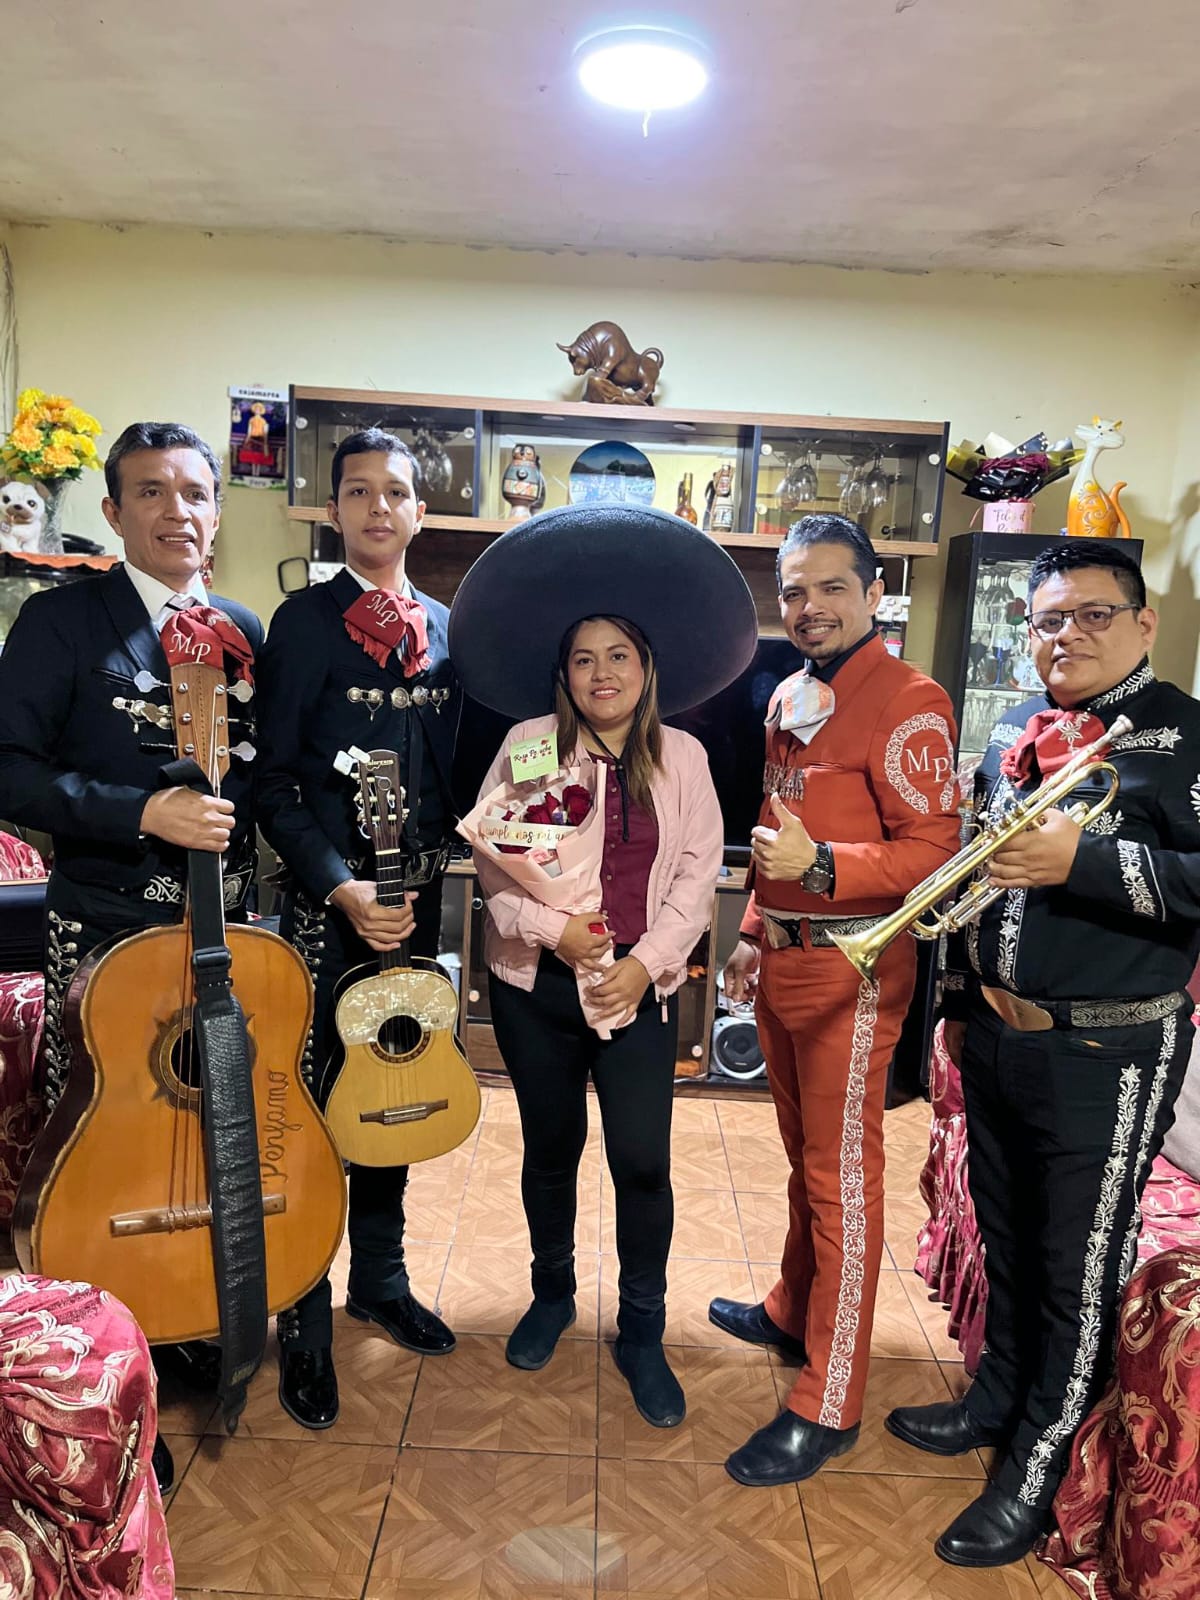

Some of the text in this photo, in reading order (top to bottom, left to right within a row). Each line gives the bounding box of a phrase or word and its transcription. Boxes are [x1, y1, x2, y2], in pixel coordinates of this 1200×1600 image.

[365, 593, 399, 629] MP
[168, 632, 211, 665] MP
[905, 745, 950, 783] MP
